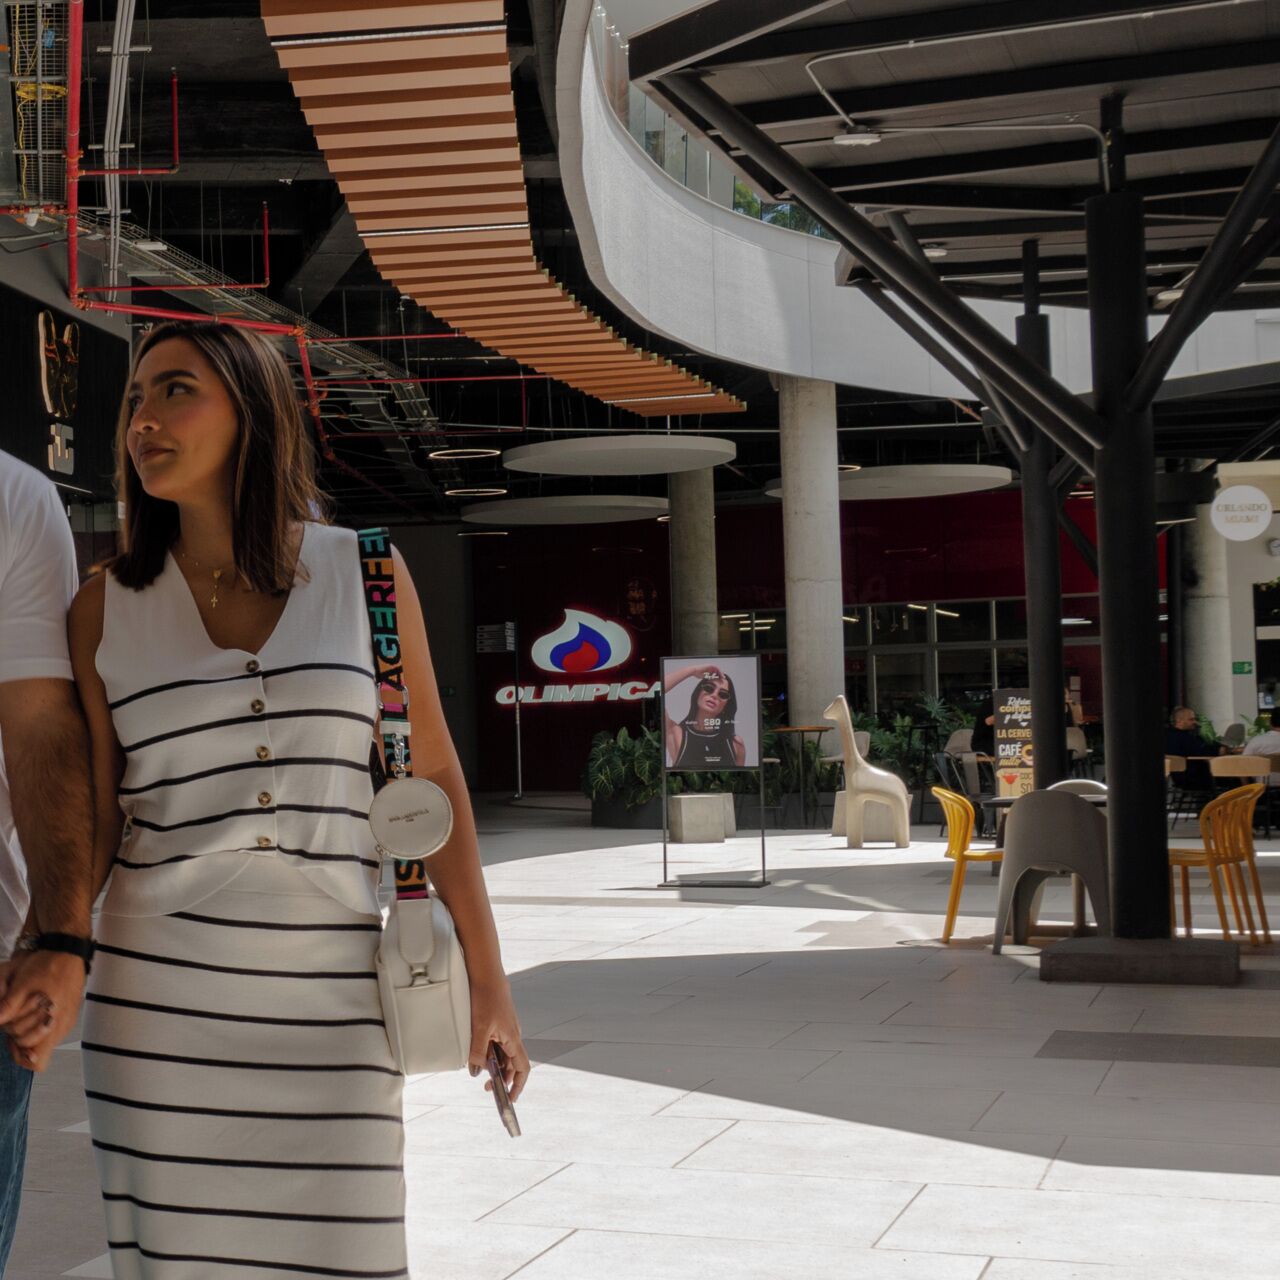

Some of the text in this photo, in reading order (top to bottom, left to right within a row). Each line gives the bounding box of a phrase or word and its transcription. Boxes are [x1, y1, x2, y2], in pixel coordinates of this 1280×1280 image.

[496, 680, 662, 705] OLIMPICA
[703, 718, 721, 726] SBQ
[996, 728, 1007, 738] LA
[998, 741, 1022, 757] CAFÉ
